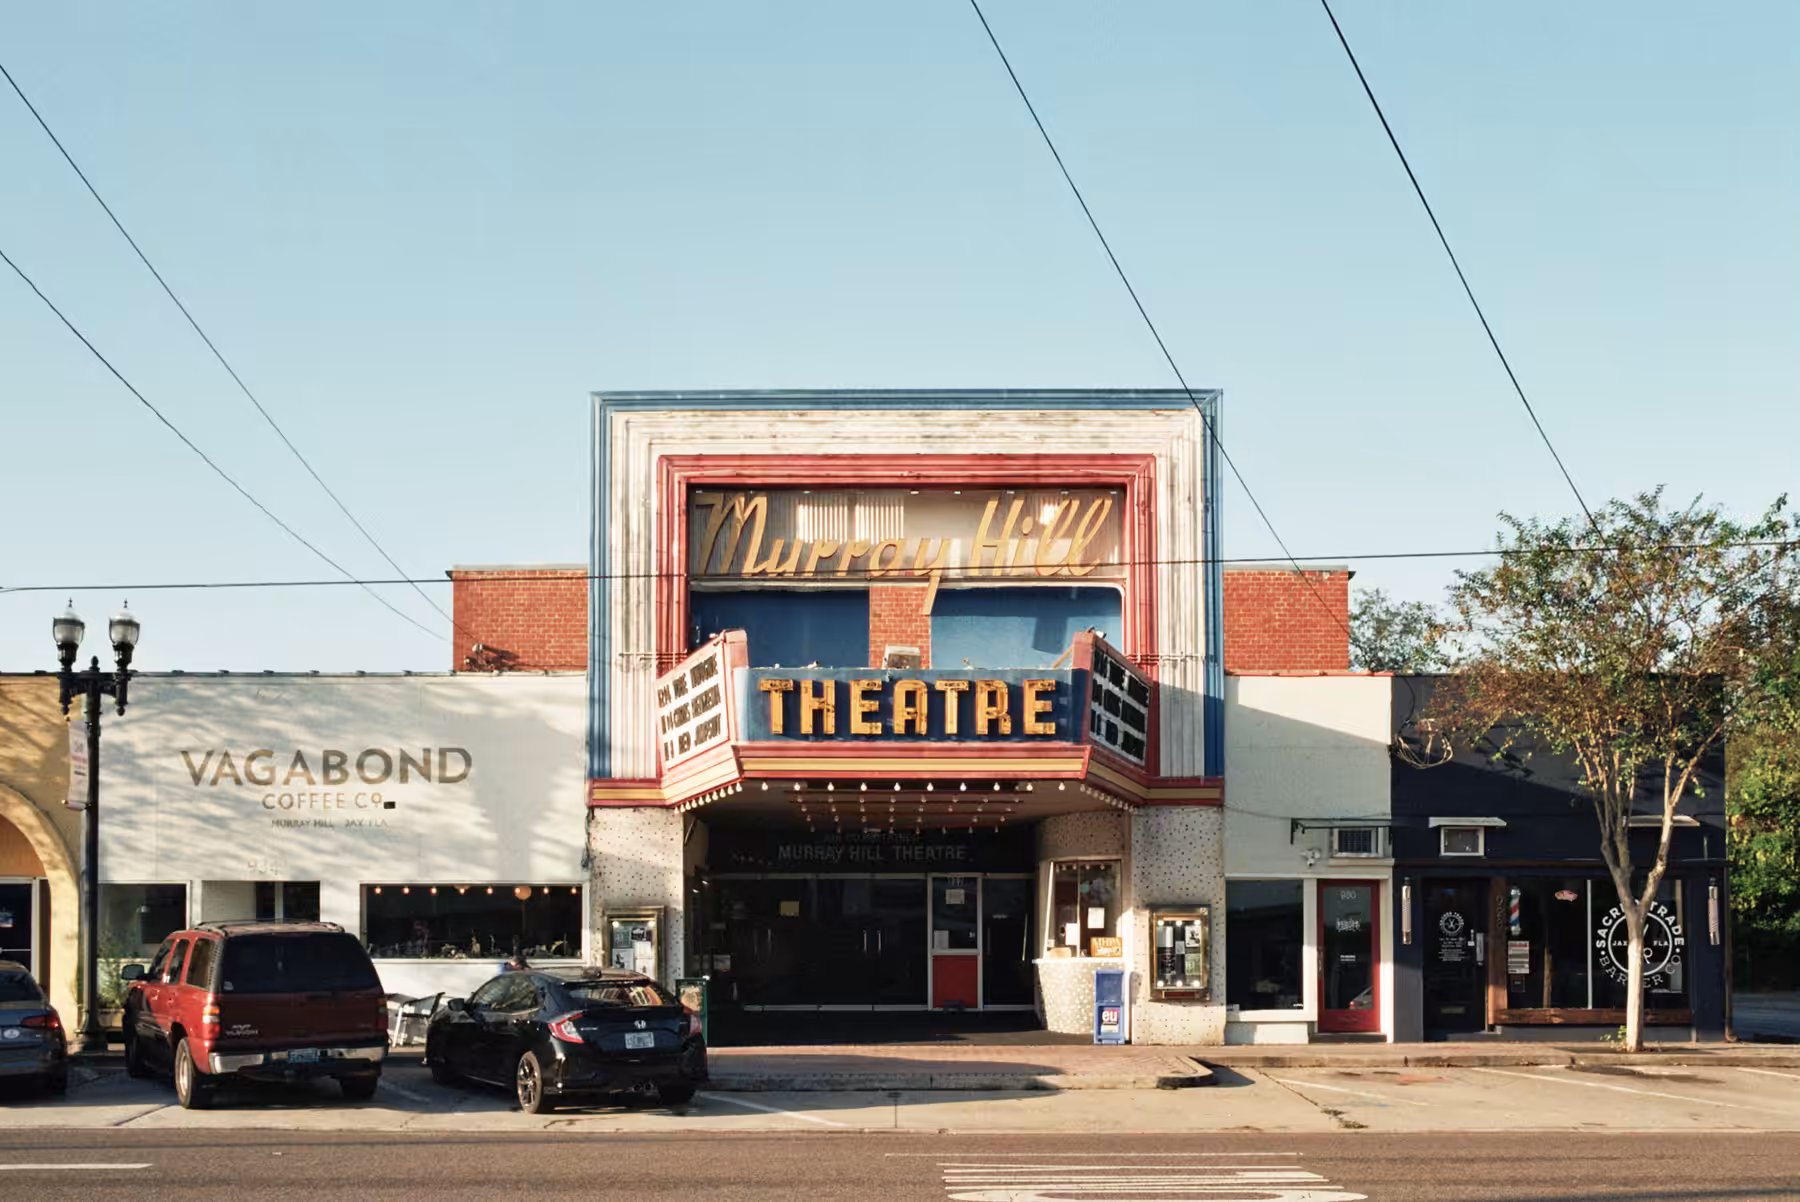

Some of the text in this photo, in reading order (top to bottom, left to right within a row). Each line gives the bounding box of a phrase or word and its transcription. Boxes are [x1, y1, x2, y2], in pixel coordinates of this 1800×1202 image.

[694, 493, 1113, 615] Murray Hill
[759, 678, 1057, 736] THEATRE
[179, 747, 473, 788] VAGABOND
[261, 792, 345, 810] COFFEE
[271, 818, 310, 829] MURRAY
[313, 818, 335, 829] HILL
[777, 844, 968, 861] MURRAY HILL THEATRE
[1649, 900, 1685, 946] TRADE
[1599, 955, 1664, 988] BARER
[1102, 1010, 1118, 1022] eu
